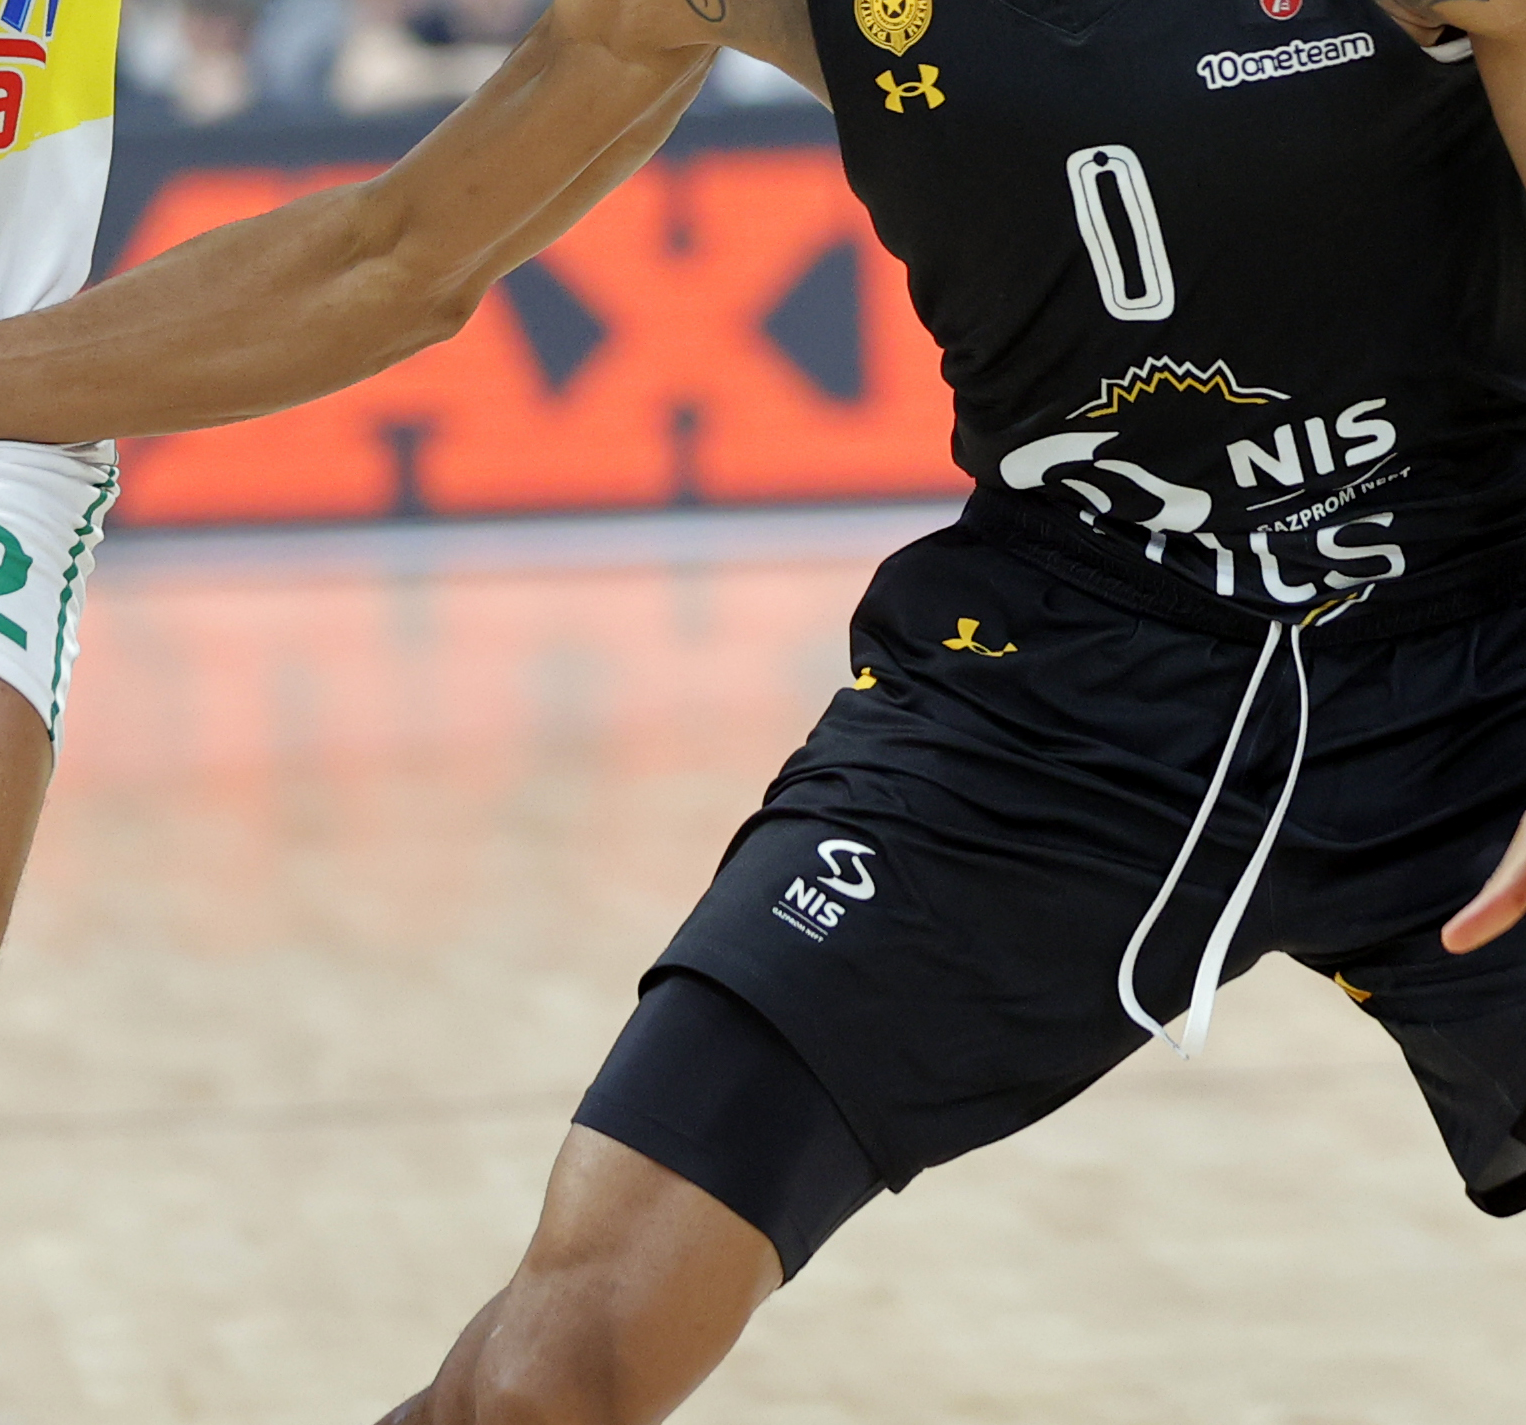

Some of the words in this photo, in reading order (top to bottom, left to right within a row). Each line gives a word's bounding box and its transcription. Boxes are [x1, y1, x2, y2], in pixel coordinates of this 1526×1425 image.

[1066, 145, 1175, 321] 0
[1226, 398, 1396, 488] NIS
[784, 876, 846, 928] NIS
